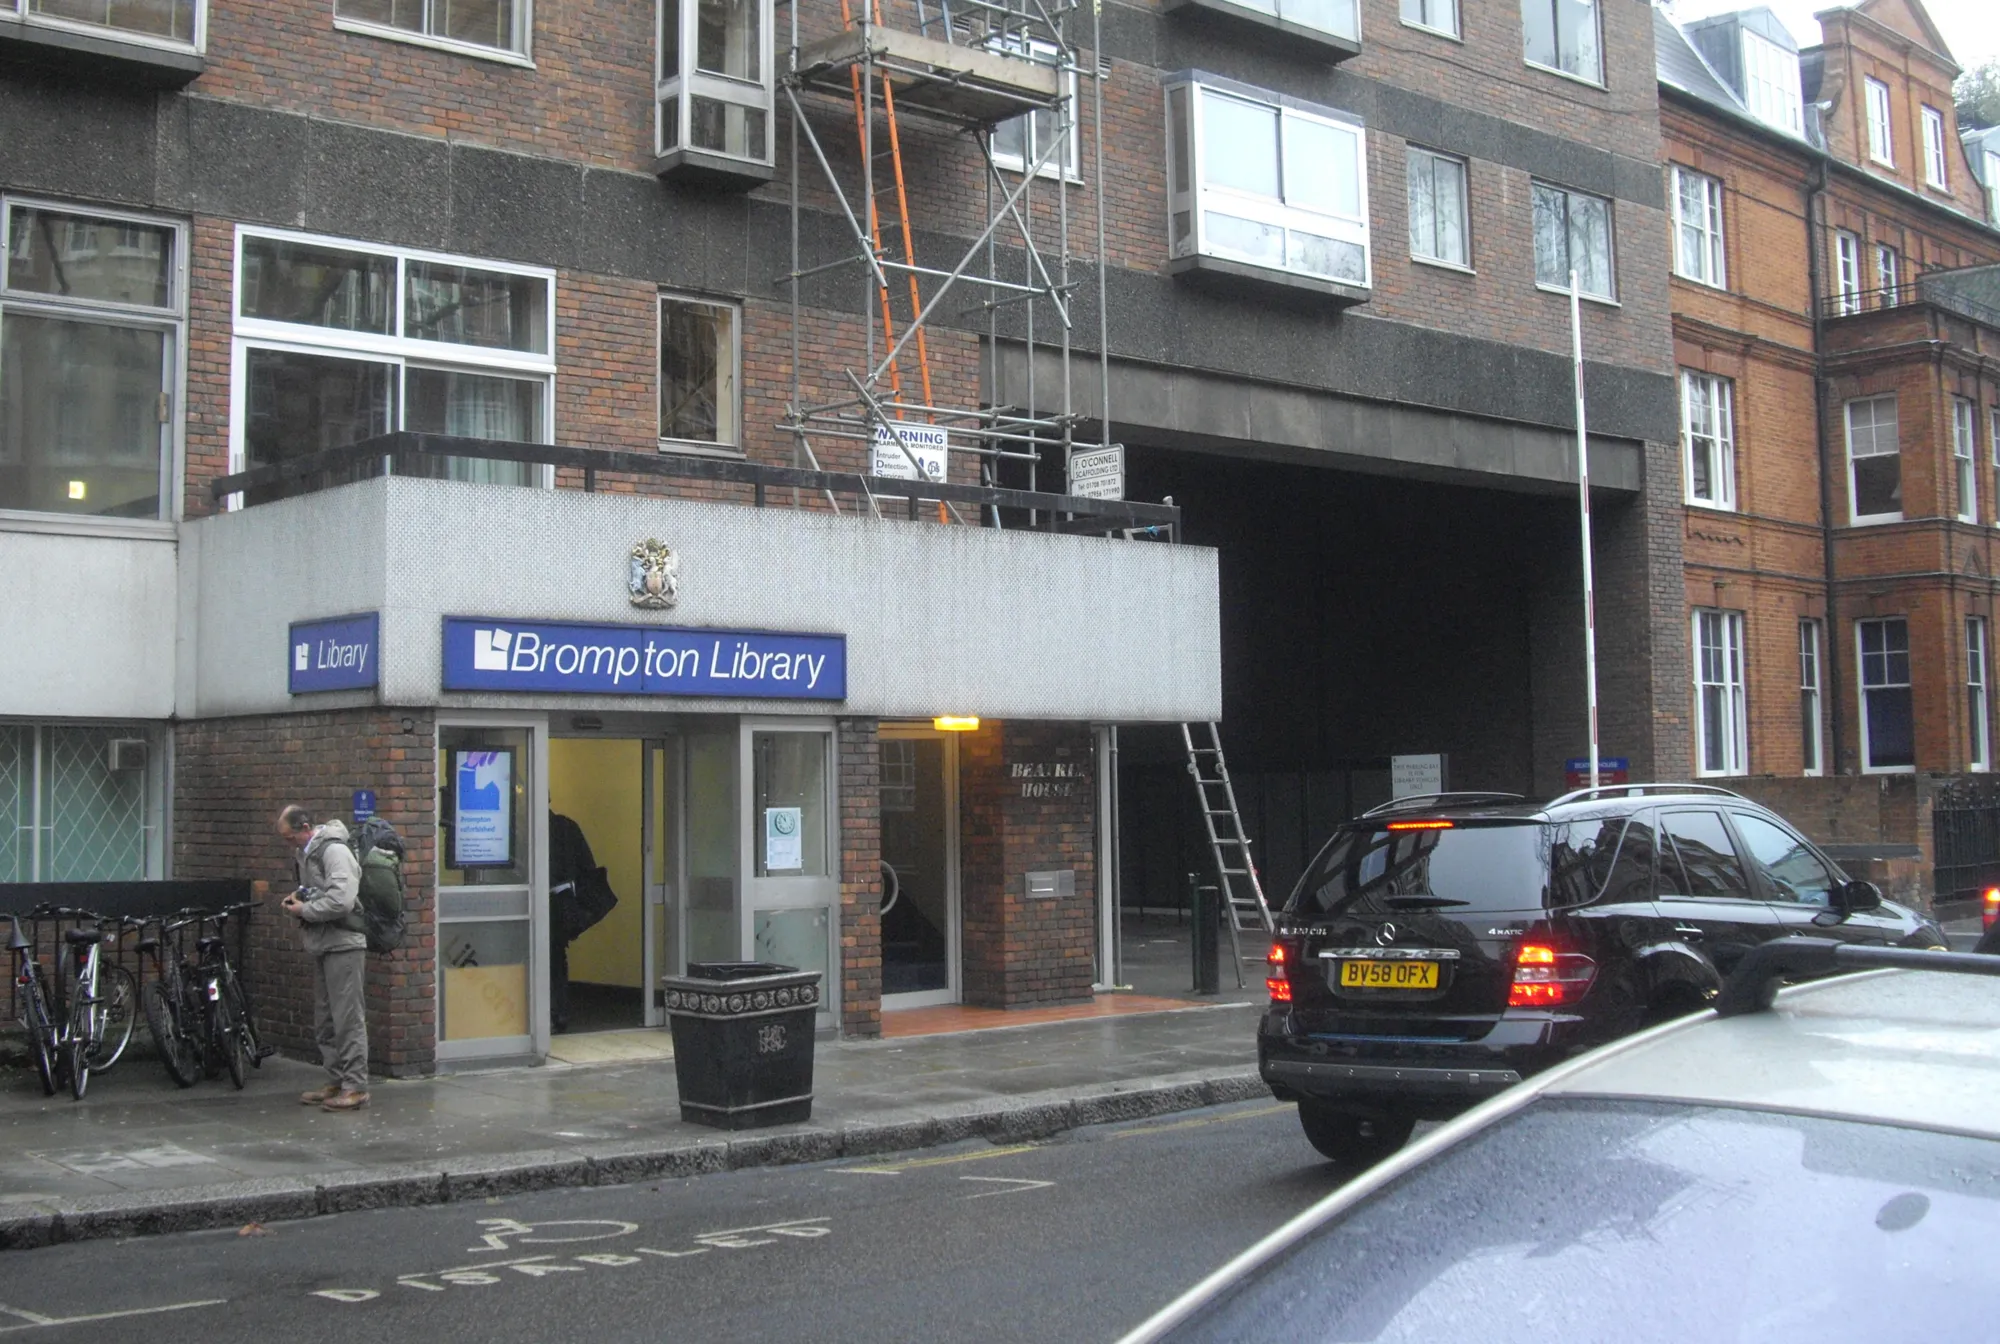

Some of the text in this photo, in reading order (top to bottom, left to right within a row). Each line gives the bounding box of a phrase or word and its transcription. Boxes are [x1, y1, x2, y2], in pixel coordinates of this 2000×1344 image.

[876, 449, 901, 459] Intruder
[910, 443, 943, 451] MONITORED
[876, 459, 908, 470] Detection
[1081, 453, 1118, 468] O'CONNELL
[1075, 464, 1118, 479] SCAFFOLDING LTD
[318, 638, 369, 673] Library
[511, 632, 825, 689] Brompton Library
[1348, 963, 1431, 984] BV58 OFX
[308, 1226, 832, 1303] DISABLED
